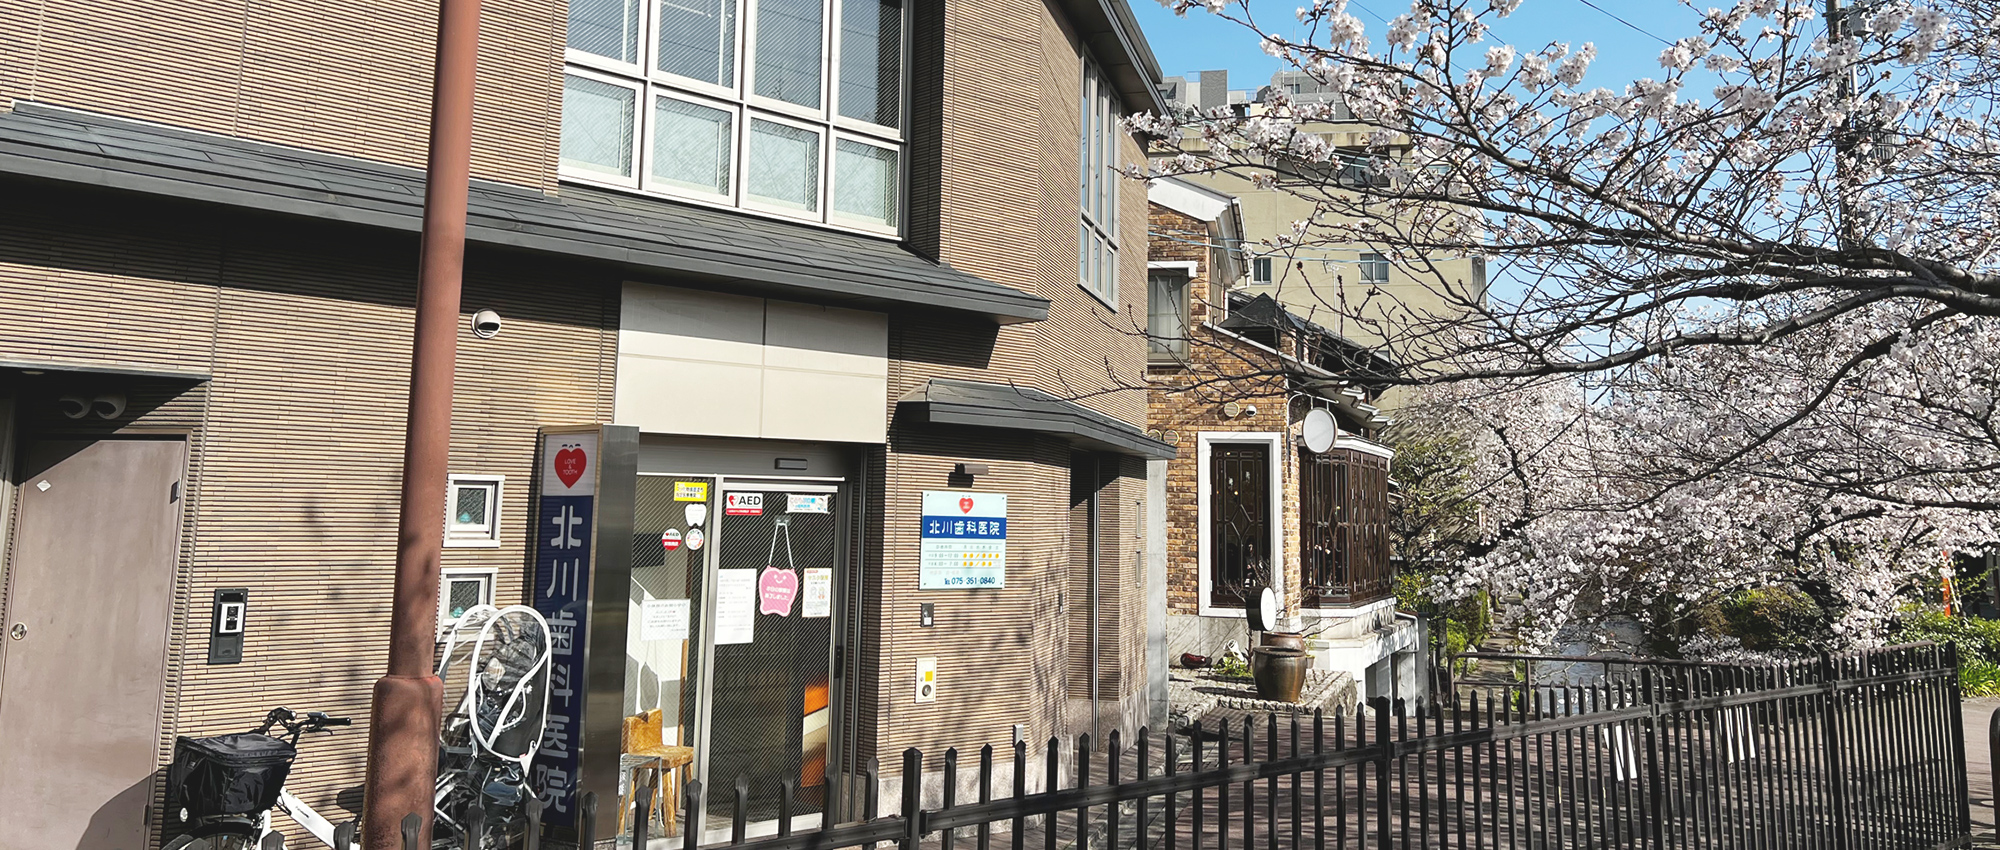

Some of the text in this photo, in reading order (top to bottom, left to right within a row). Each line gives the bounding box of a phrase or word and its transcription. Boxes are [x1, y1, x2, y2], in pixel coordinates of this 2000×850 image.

[738, 496, 761, 505] AED
[929, 519, 1000, 536] 北川歯科医院
